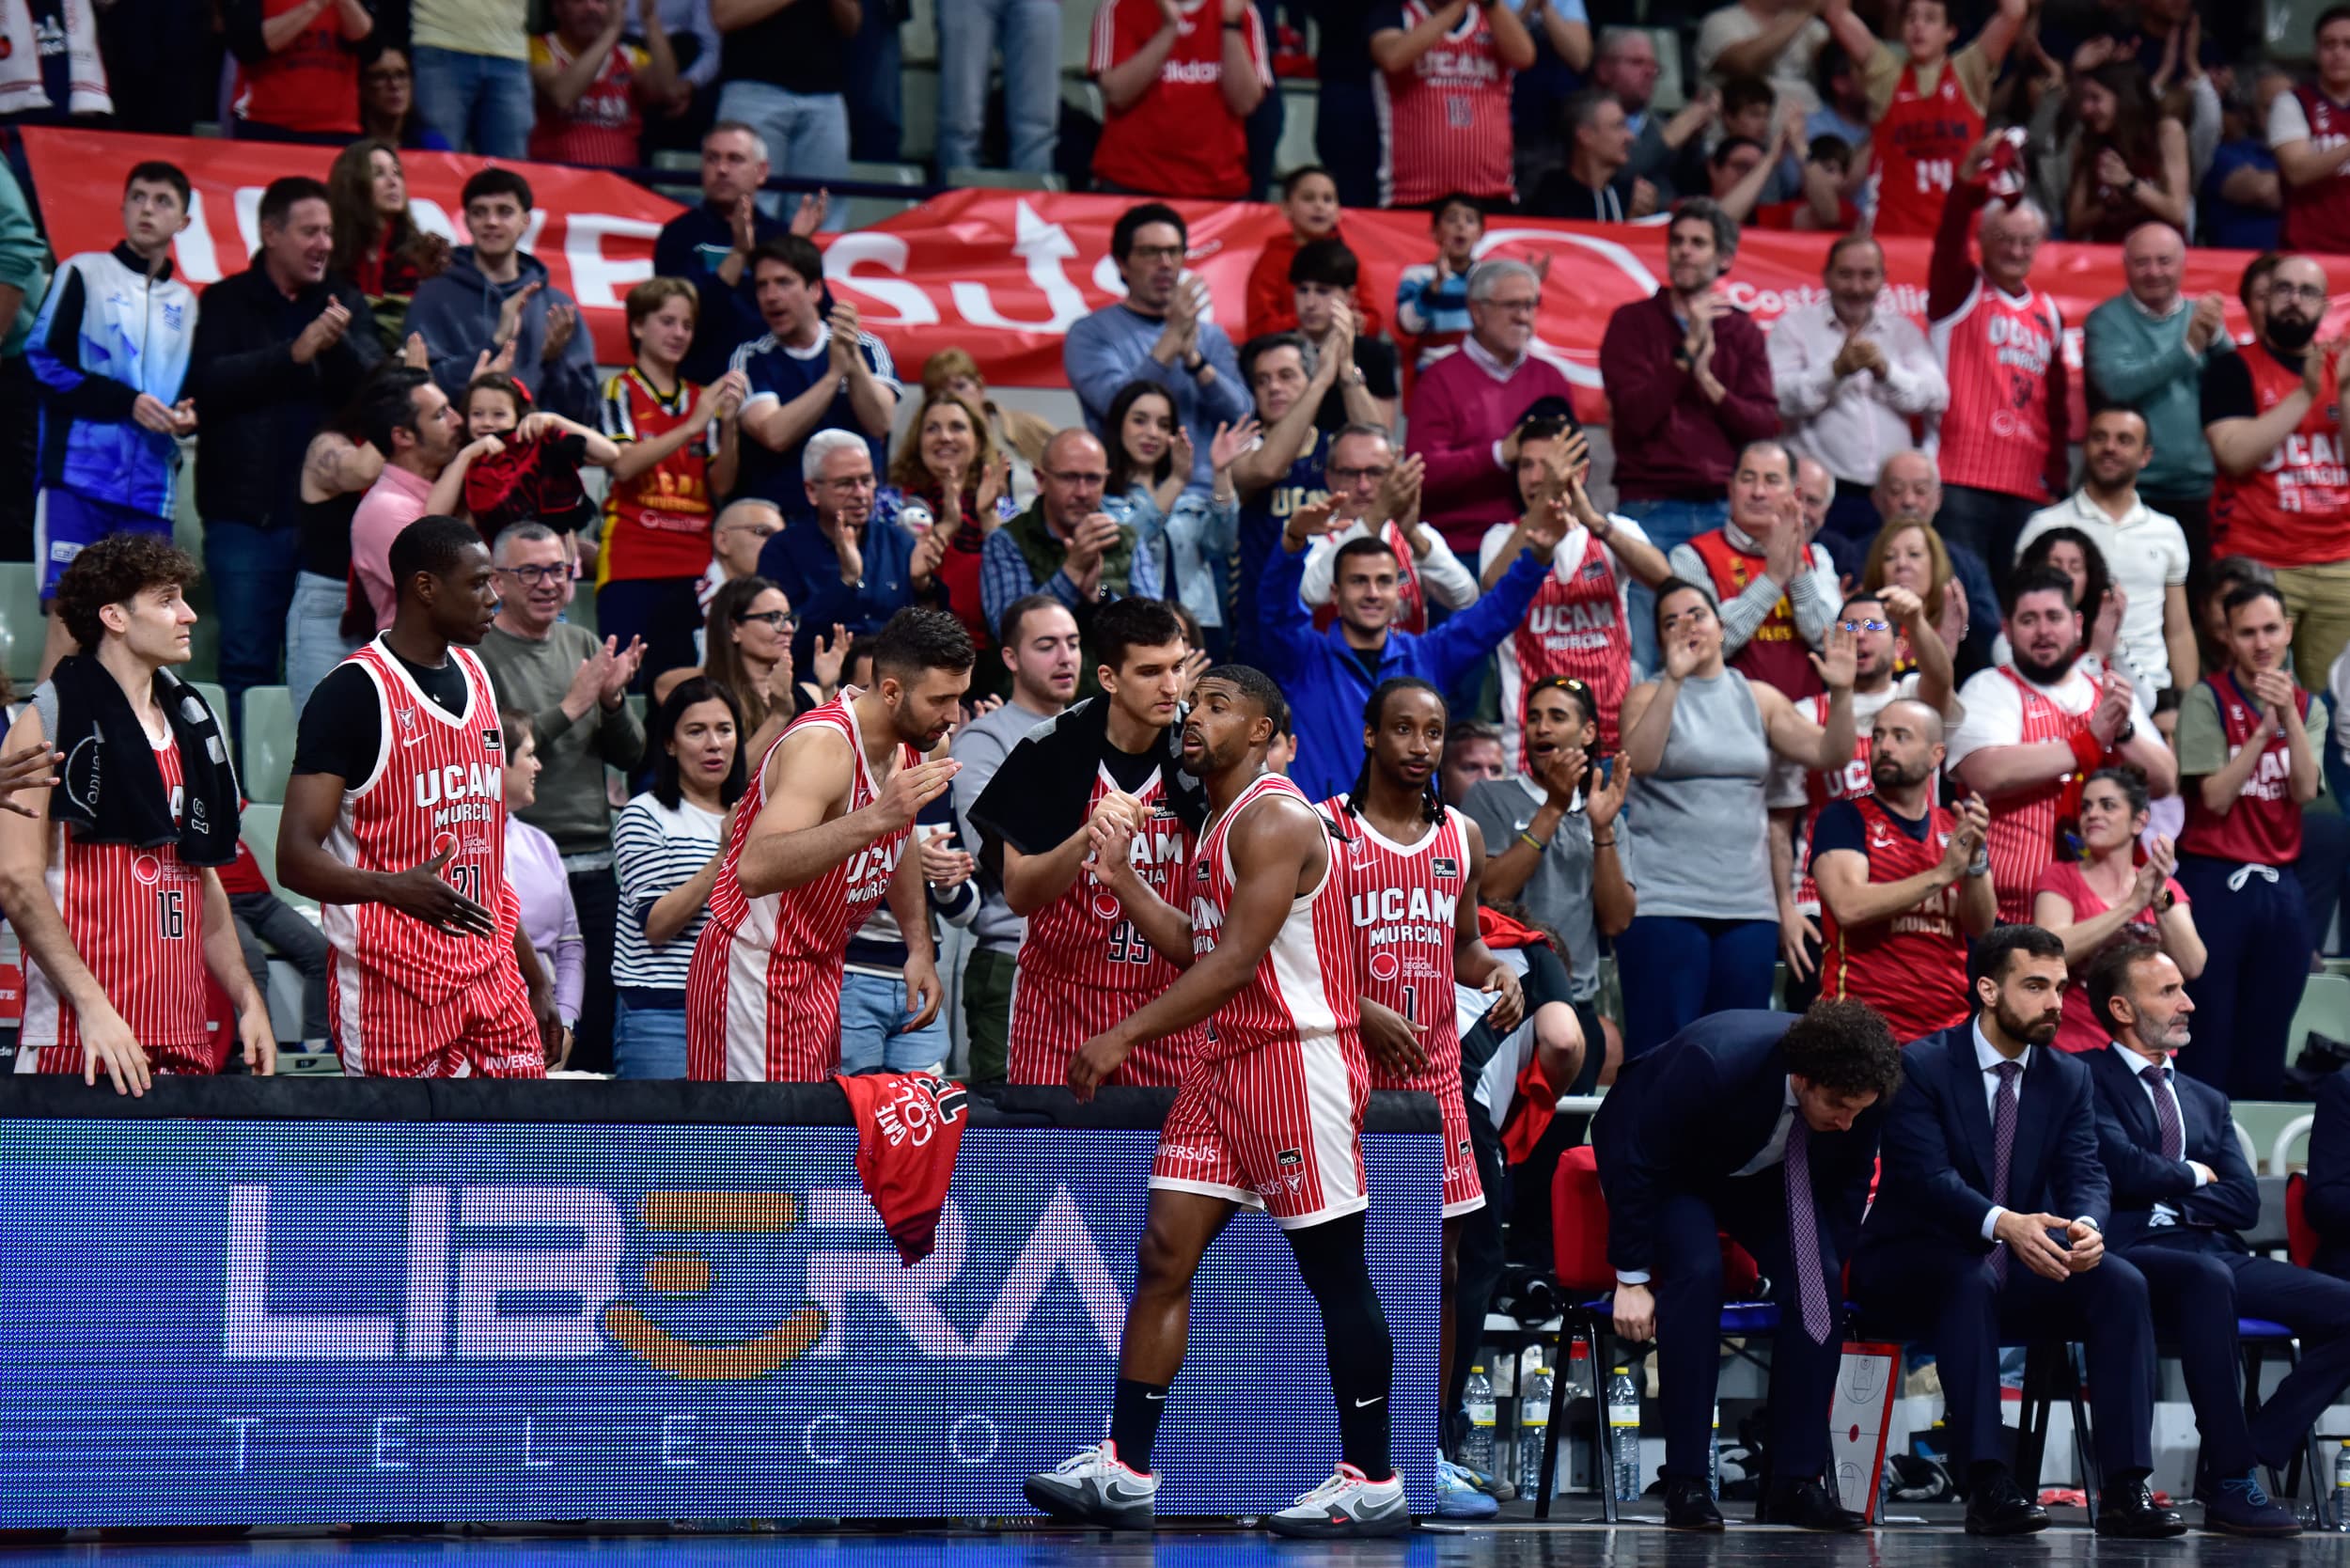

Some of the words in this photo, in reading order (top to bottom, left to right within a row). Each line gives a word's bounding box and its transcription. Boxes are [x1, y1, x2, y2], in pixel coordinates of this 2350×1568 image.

[1528, 601, 1617, 635] UCAM
[1543, 632, 1609, 651] MURCIA
[415, 762, 502, 808] UCAM
[434, 802, 493, 828] MURCIA
[451, 864, 481, 905] 21
[157, 889, 184, 939] 16
[1351, 886, 1456, 929] UCAM
[1107, 918, 1151, 965] 95
[1370, 924, 1444, 948] MURCIA
[1414, 969, 1443, 979] MURCIA
[1402, 984, 1417, 1022] 1
[485, 1052, 545, 1070] INVERSUS
[1279, 1156, 1297, 1166] acb
[222, 1182, 1130, 1380] LIBERA
[222, 1413, 1113, 1472] TELECO
